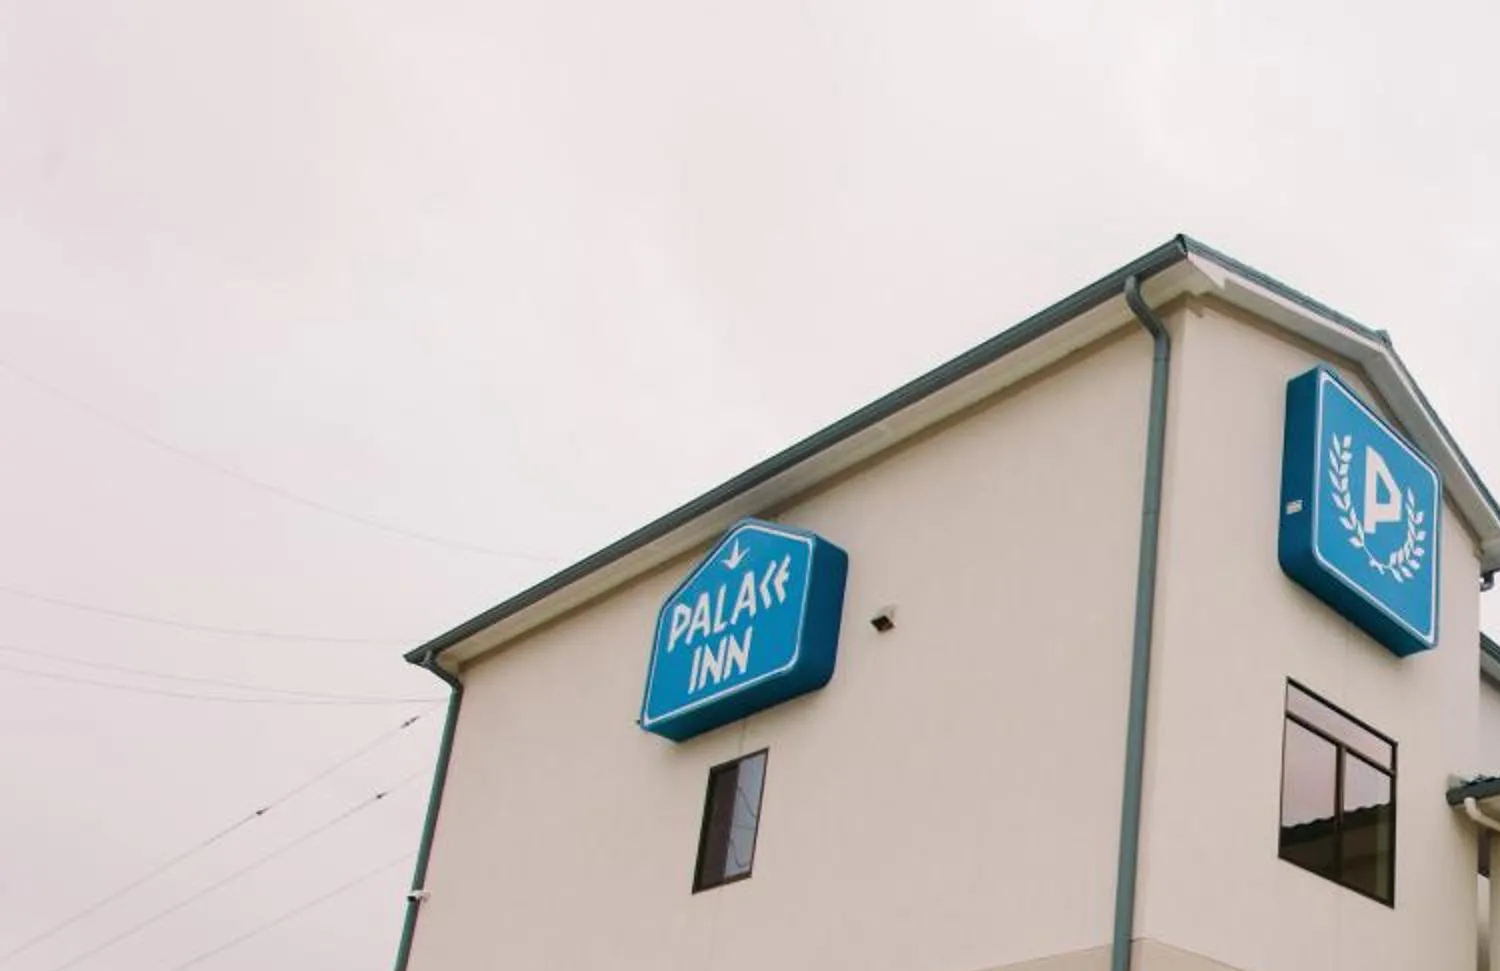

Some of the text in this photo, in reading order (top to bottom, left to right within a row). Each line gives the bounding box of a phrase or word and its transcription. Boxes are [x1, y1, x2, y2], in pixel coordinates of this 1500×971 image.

[1363, 445, 1401, 534] P
[667, 553, 792, 653] PALACE
[687, 625, 753, 695] INN
